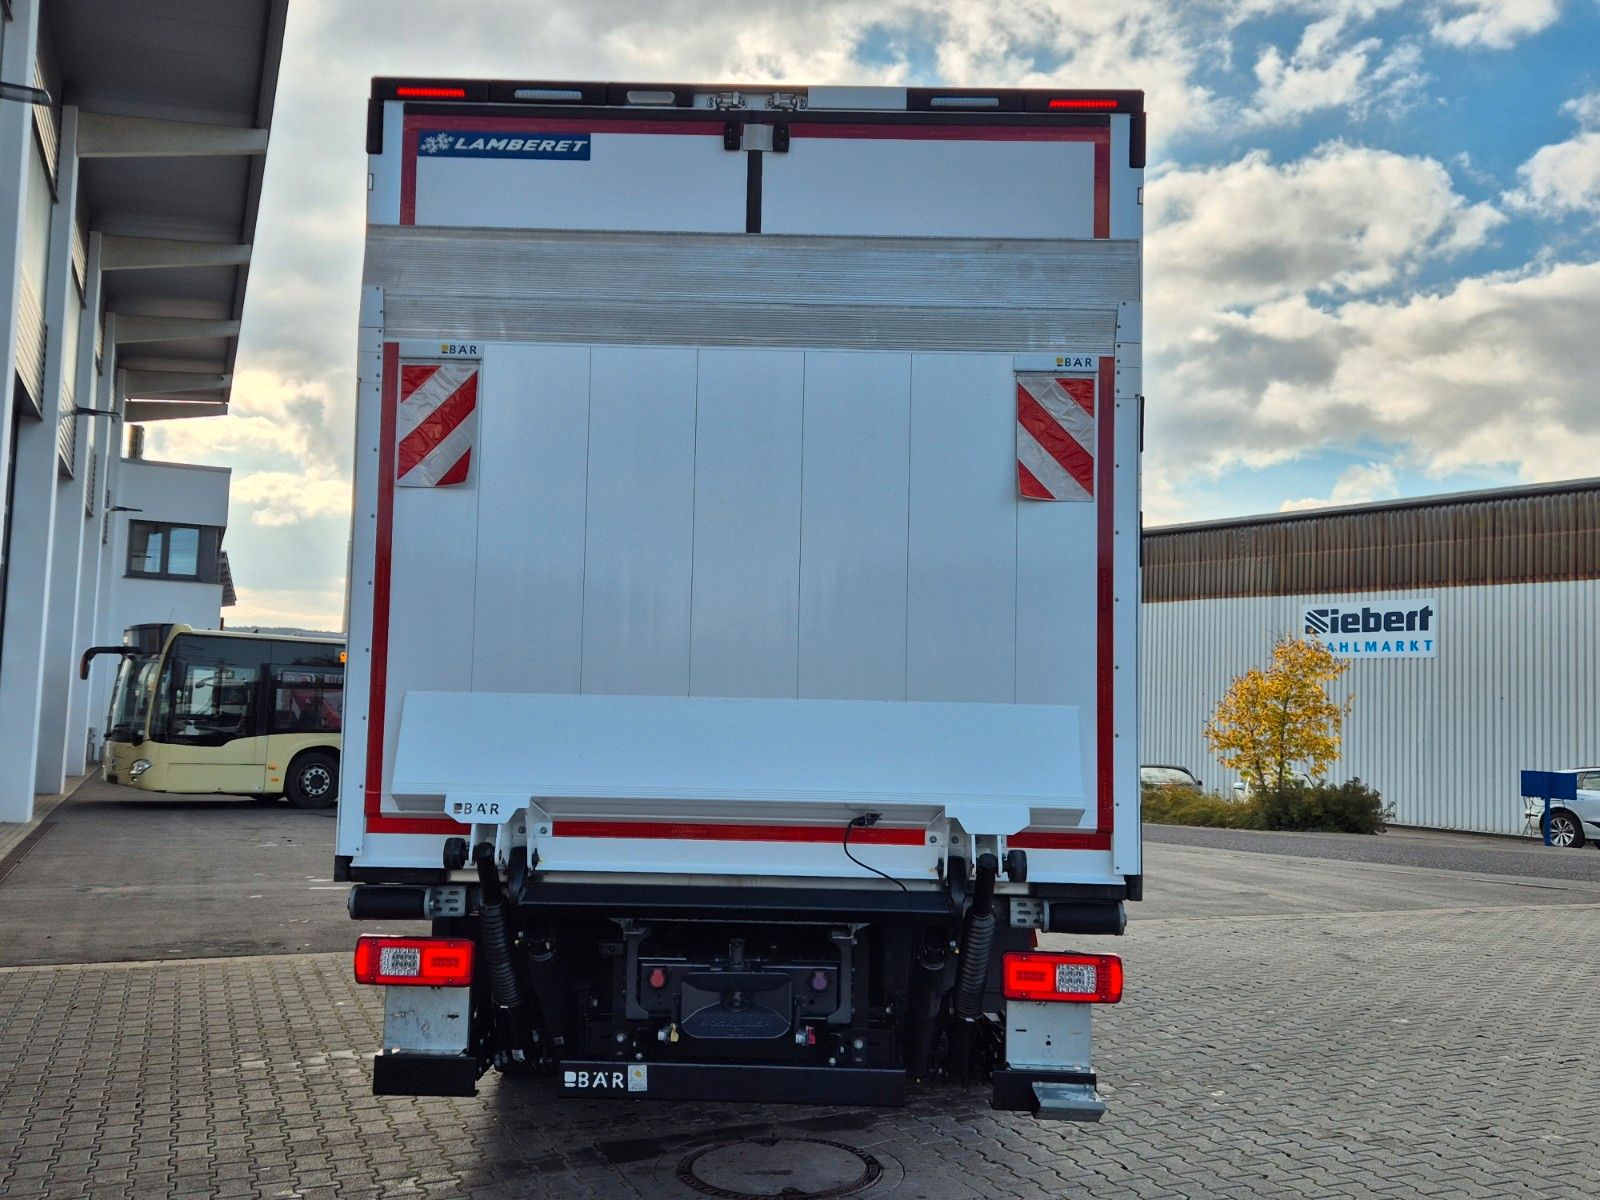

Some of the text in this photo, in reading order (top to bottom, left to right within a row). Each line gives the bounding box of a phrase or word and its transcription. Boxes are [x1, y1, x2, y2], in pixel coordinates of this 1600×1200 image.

[454, 137, 588, 152] LAMBERET
[1305, 605, 1433, 635] Siebert
[1327, 640, 1433, 653] AHLMARKT
[578, 1071, 624, 1089] BÄR
